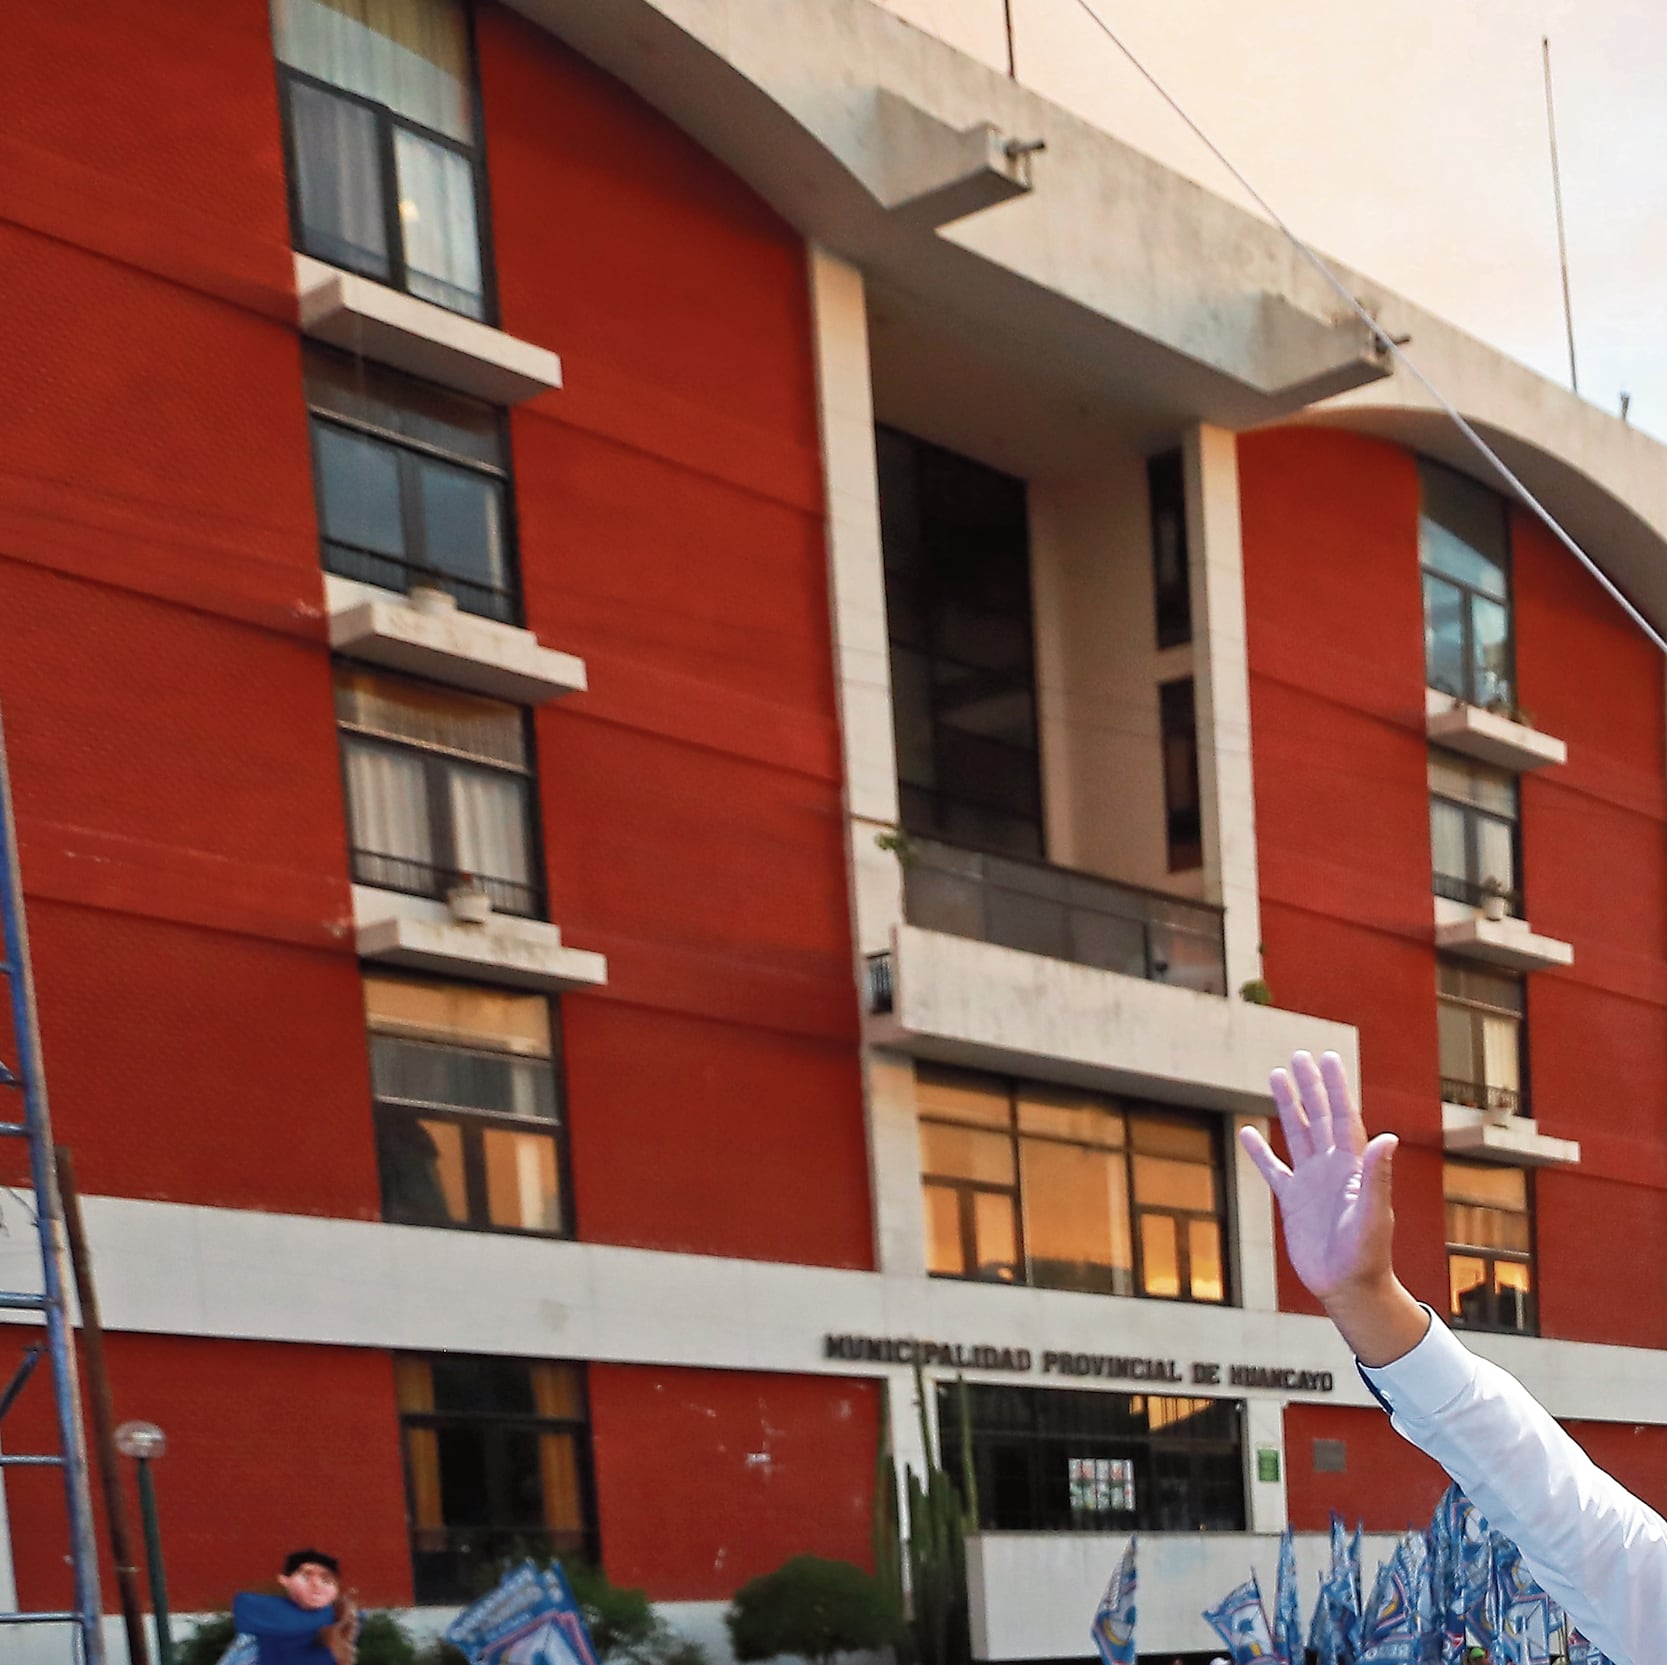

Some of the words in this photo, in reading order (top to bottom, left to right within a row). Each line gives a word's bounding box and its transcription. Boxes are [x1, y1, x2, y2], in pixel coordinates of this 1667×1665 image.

[824, 1334, 1032, 1370] MUNICIPALIDAD
[1043, 1350, 1182, 1384] PROVINCIAL
[1191, 1361, 1221, 1385] DE
[1230, 1364, 1334, 1392] HUANCAYO
